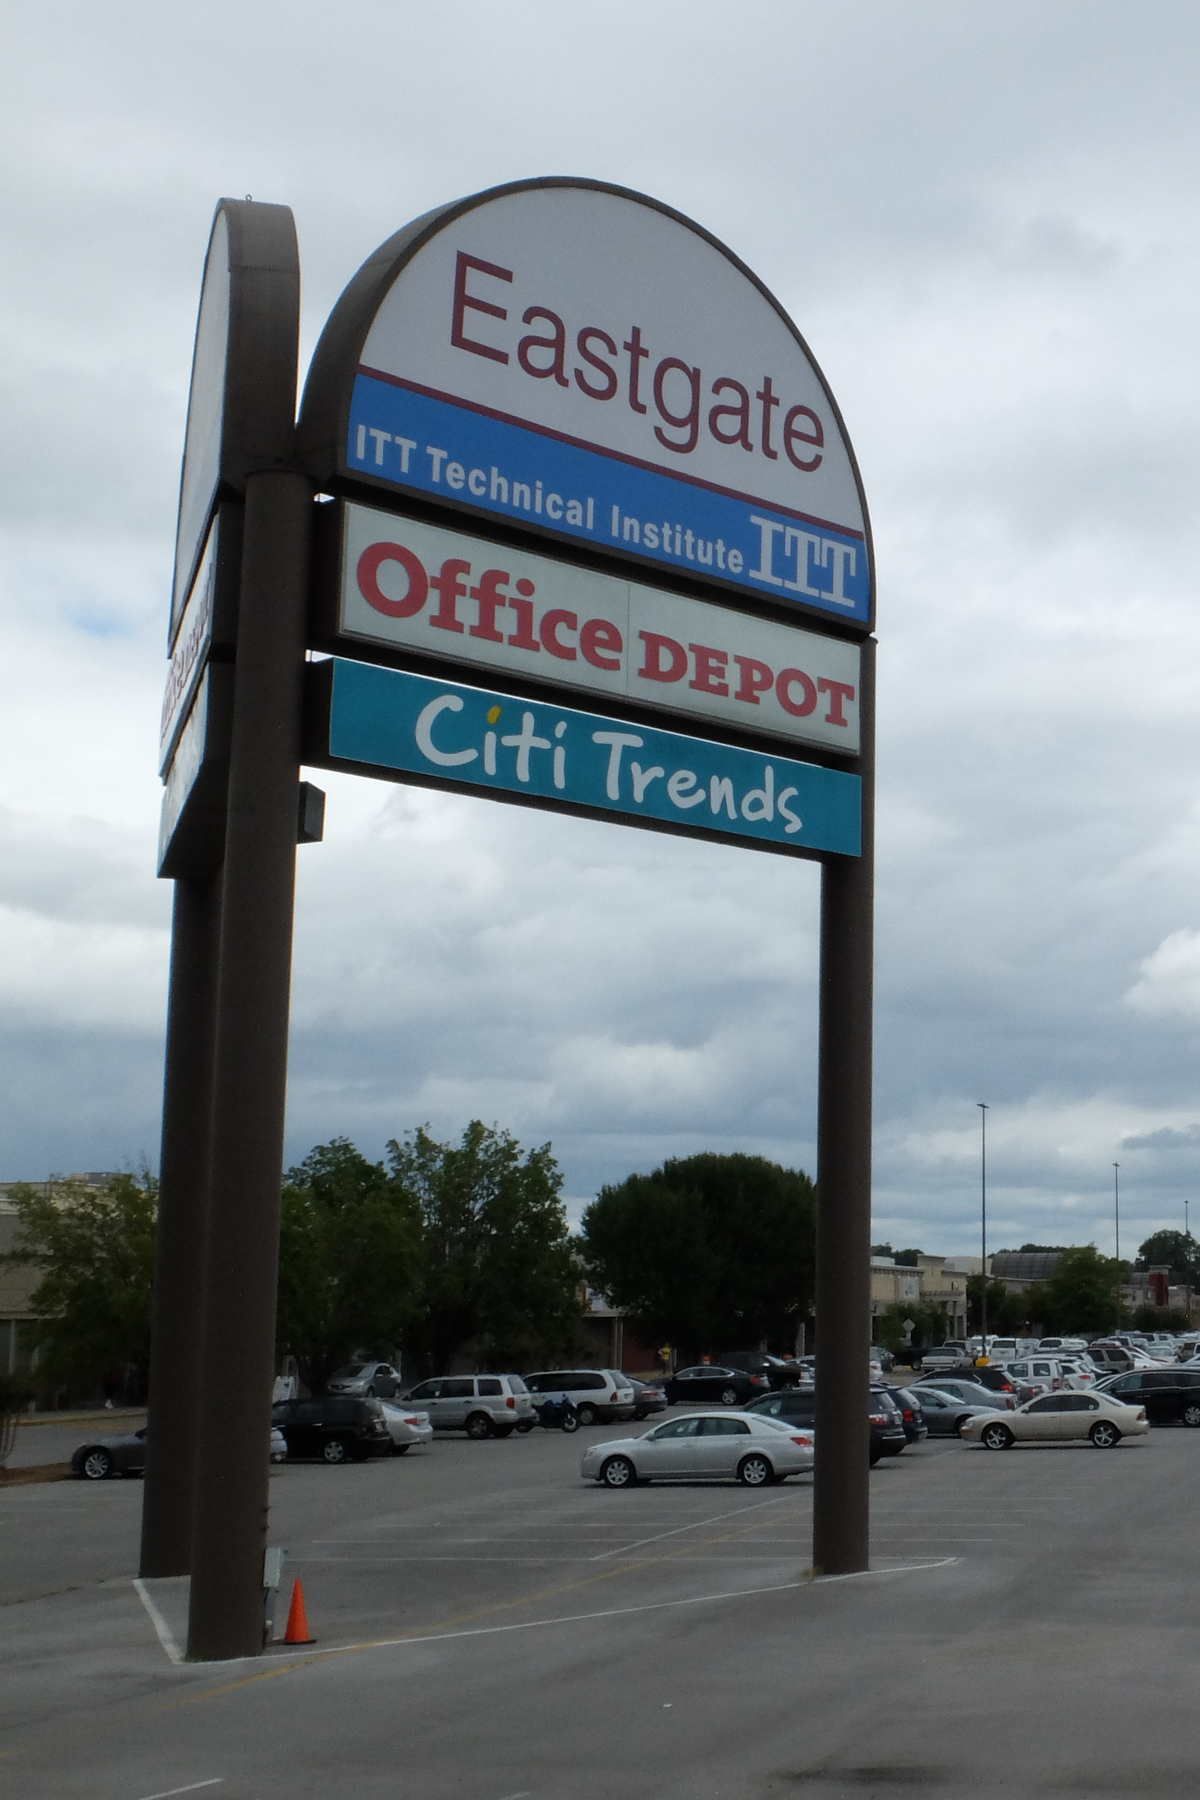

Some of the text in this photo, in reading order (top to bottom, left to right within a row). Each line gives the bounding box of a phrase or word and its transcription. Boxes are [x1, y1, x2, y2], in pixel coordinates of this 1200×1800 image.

[452, 250, 824, 472] Eastgate
[356, 425, 856, 608] ITT Technical Institute ITT
[356, 541, 855, 727] Office DEPOT
[414, 695, 803, 834] Citi Trends
